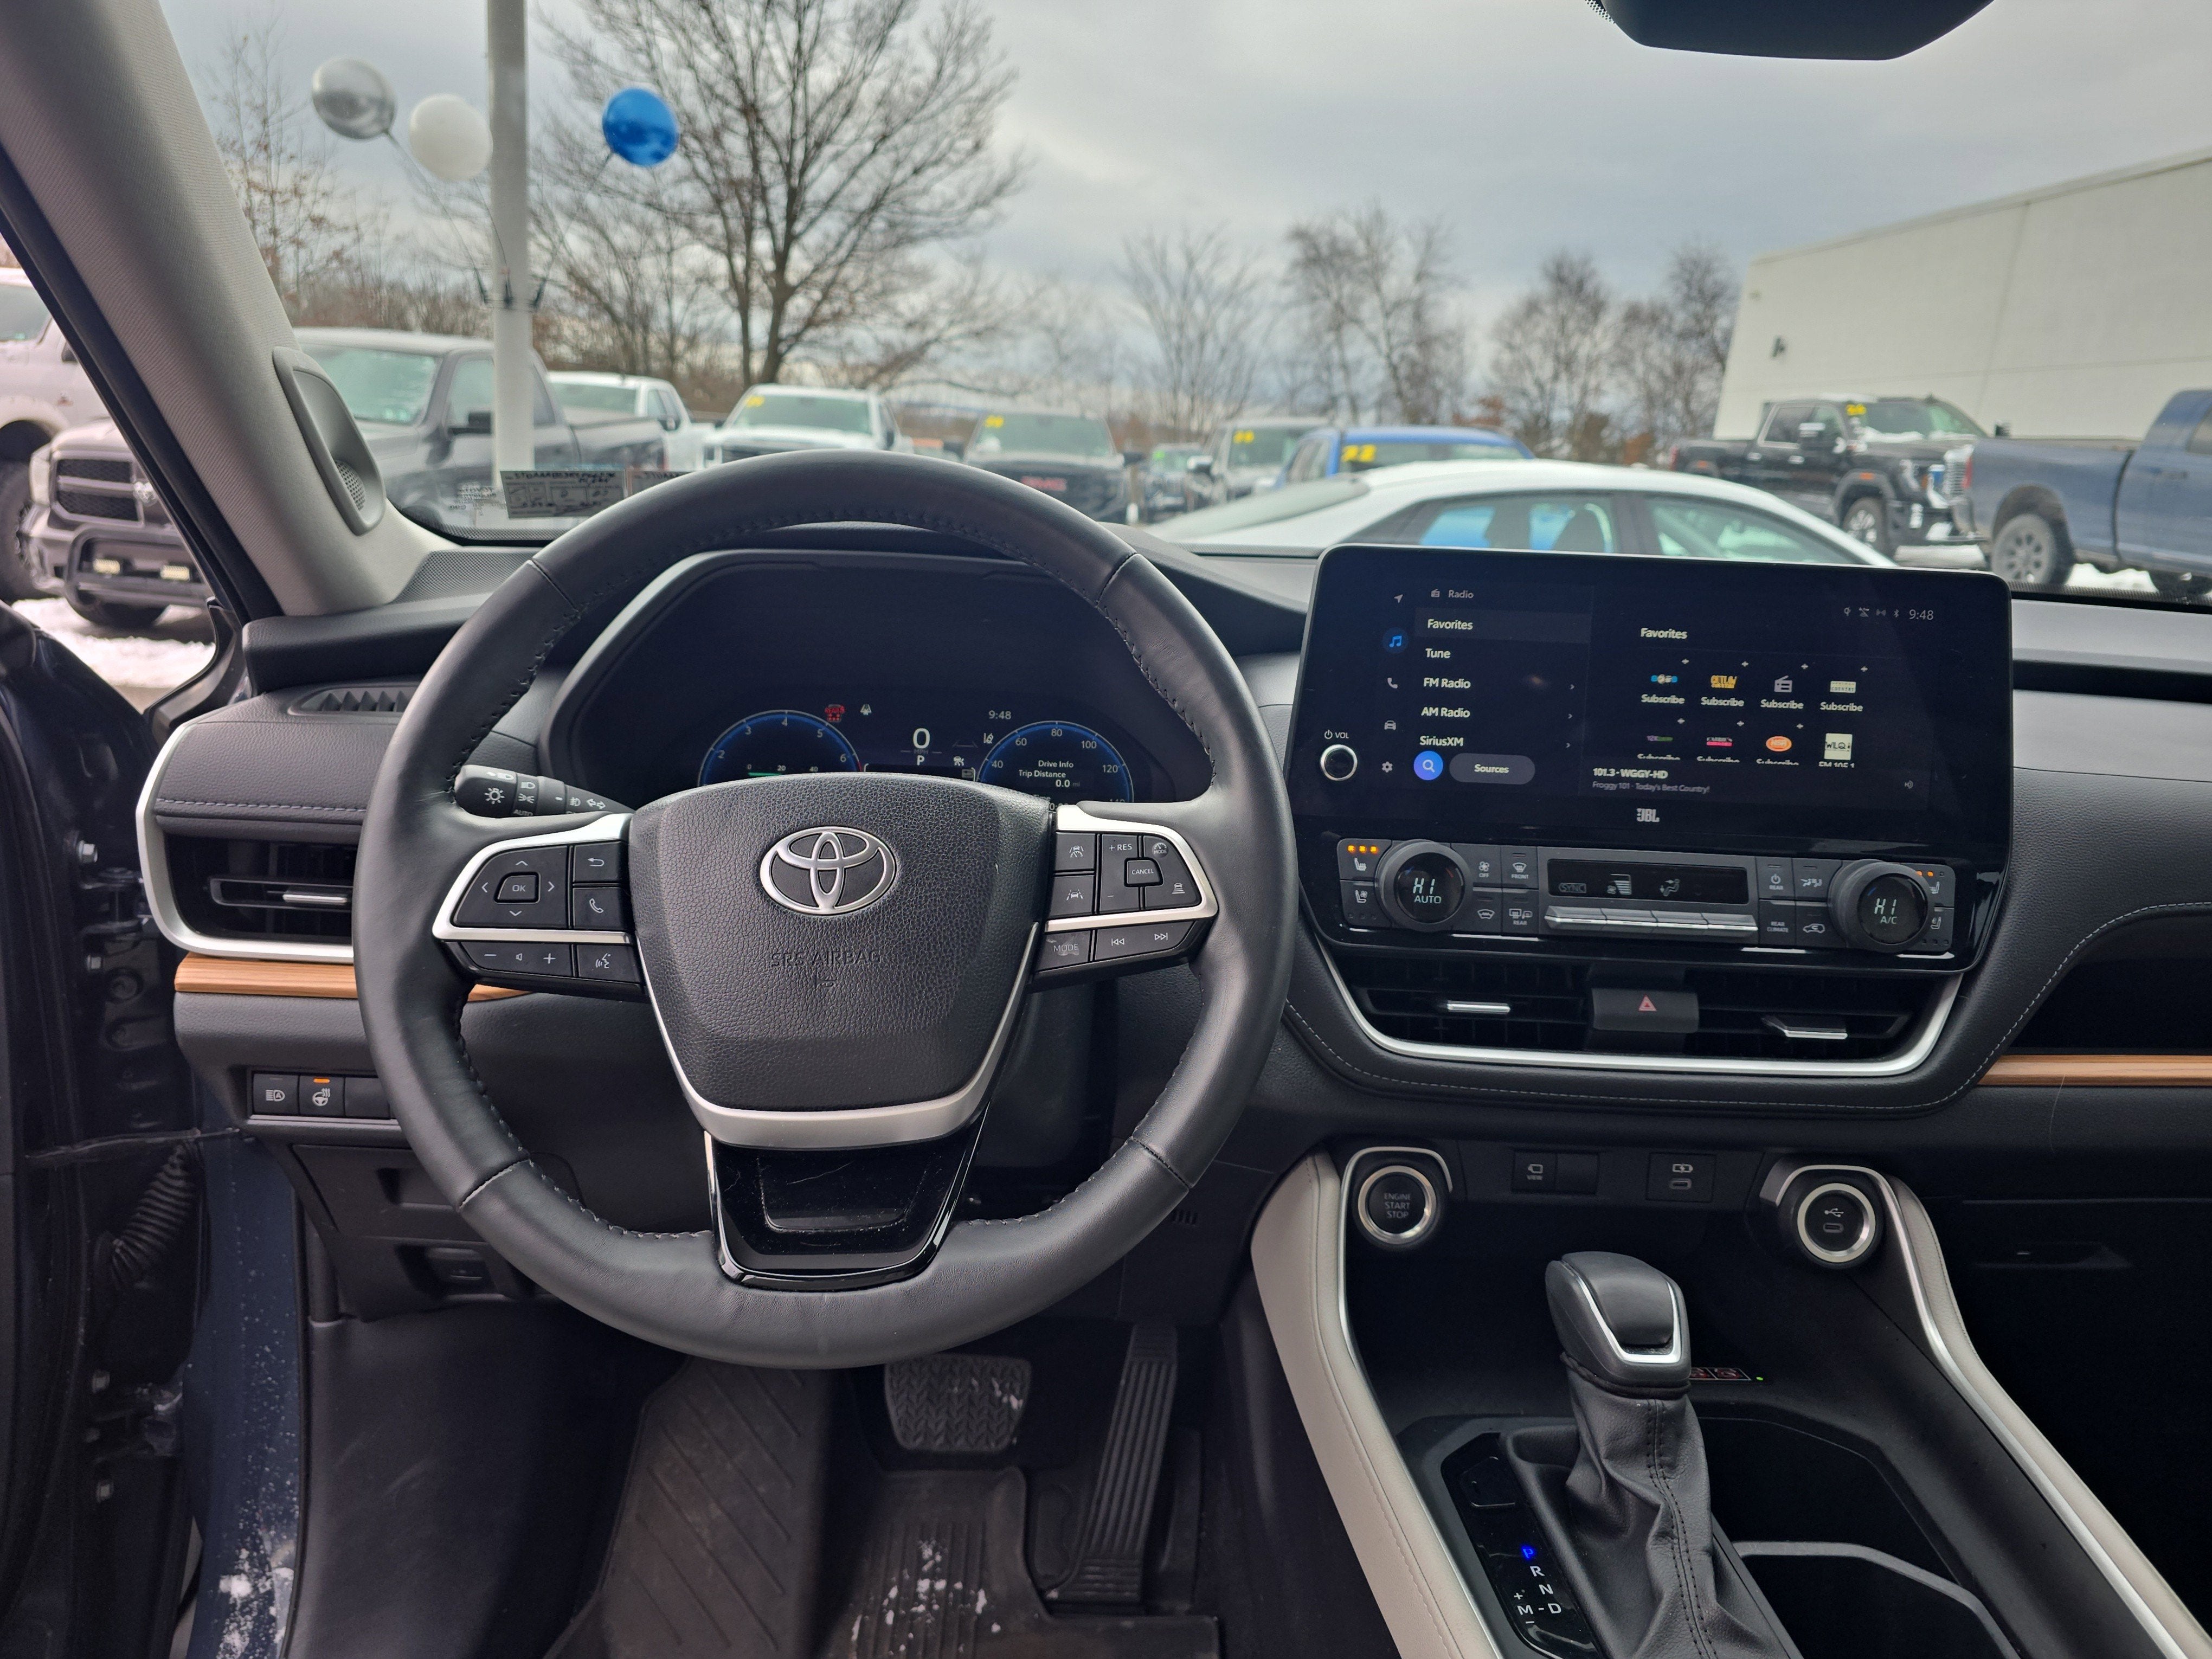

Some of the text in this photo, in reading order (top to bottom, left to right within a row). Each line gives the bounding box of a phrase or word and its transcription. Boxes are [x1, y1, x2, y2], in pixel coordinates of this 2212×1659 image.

[1448, 590, 1474, 599] Radio
[1909, 609, 1934, 620] 9:48
[1427, 619, 1473, 630] Favorites
[1640, 628, 1688, 639] Favorites
[1425, 648, 1451, 659] Tune
[1423, 677, 1471, 689] FM Radio
[1641, 694, 1686, 704] Subscribe
[1701, 696, 1744, 707] Subscribe
[1760, 699, 1804, 709] Subscribe
[1820, 702, 1863, 712] Subscribe
[988, 710, 1012, 719] 9:48
[1421, 707, 1470, 718] AM Radio
[781, 717, 788, 726] 4
[745, 726, 752, 735] 3
[817, 729, 823, 737] 5
[1051, 728, 1063, 737] 80
[912, 728, 930, 749] 0
[1015, 737, 1027, 747] 60
[1419, 736, 1464, 747] SiriusXM
[1081, 741, 1097, 749] 100
[718, 750, 725, 759] 2
[840, 754, 847, 762] 6
[916, 755, 925, 766] P
[992, 760, 1003, 769] 40
[1059, 760, 1074, 768] Info
[1102, 764, 1118, 773] 120
[1474, 764, 1509, 774] Sources
[1593, 768, 1616, 777] 101.3
[1620, 769, 1669, 779] WGGY-HD
[1019, 770, 1032, 778] Trip
[1056, 779, 1070, 788] 0.0
[1592, 781, 1618, 790] Froggy
[1636, 783, 1661, 792] Today's
[1679, 785, 1710, 795] Country!
[1636, 808, 1660, 822] JBL
[1414, 895, 1442, 904] AUTO
[1880, 916, 1897, 924] A/C
[1053, 943, 1078, 953] MODE
[770, 950, 883, 968] SRS AIRBAG
[1384, 1201, 1410, 1210] START
[1387, 1210, 1409, 1219] STOP
[1522, 1548, 1534, 1559] P
[1530, 1565, 1545, 1577] R
[1539, 1584, 1554, 1596] N
[1517, 1605, 1534, 1616] M
[1547, 1603, 1561, 1614] D
